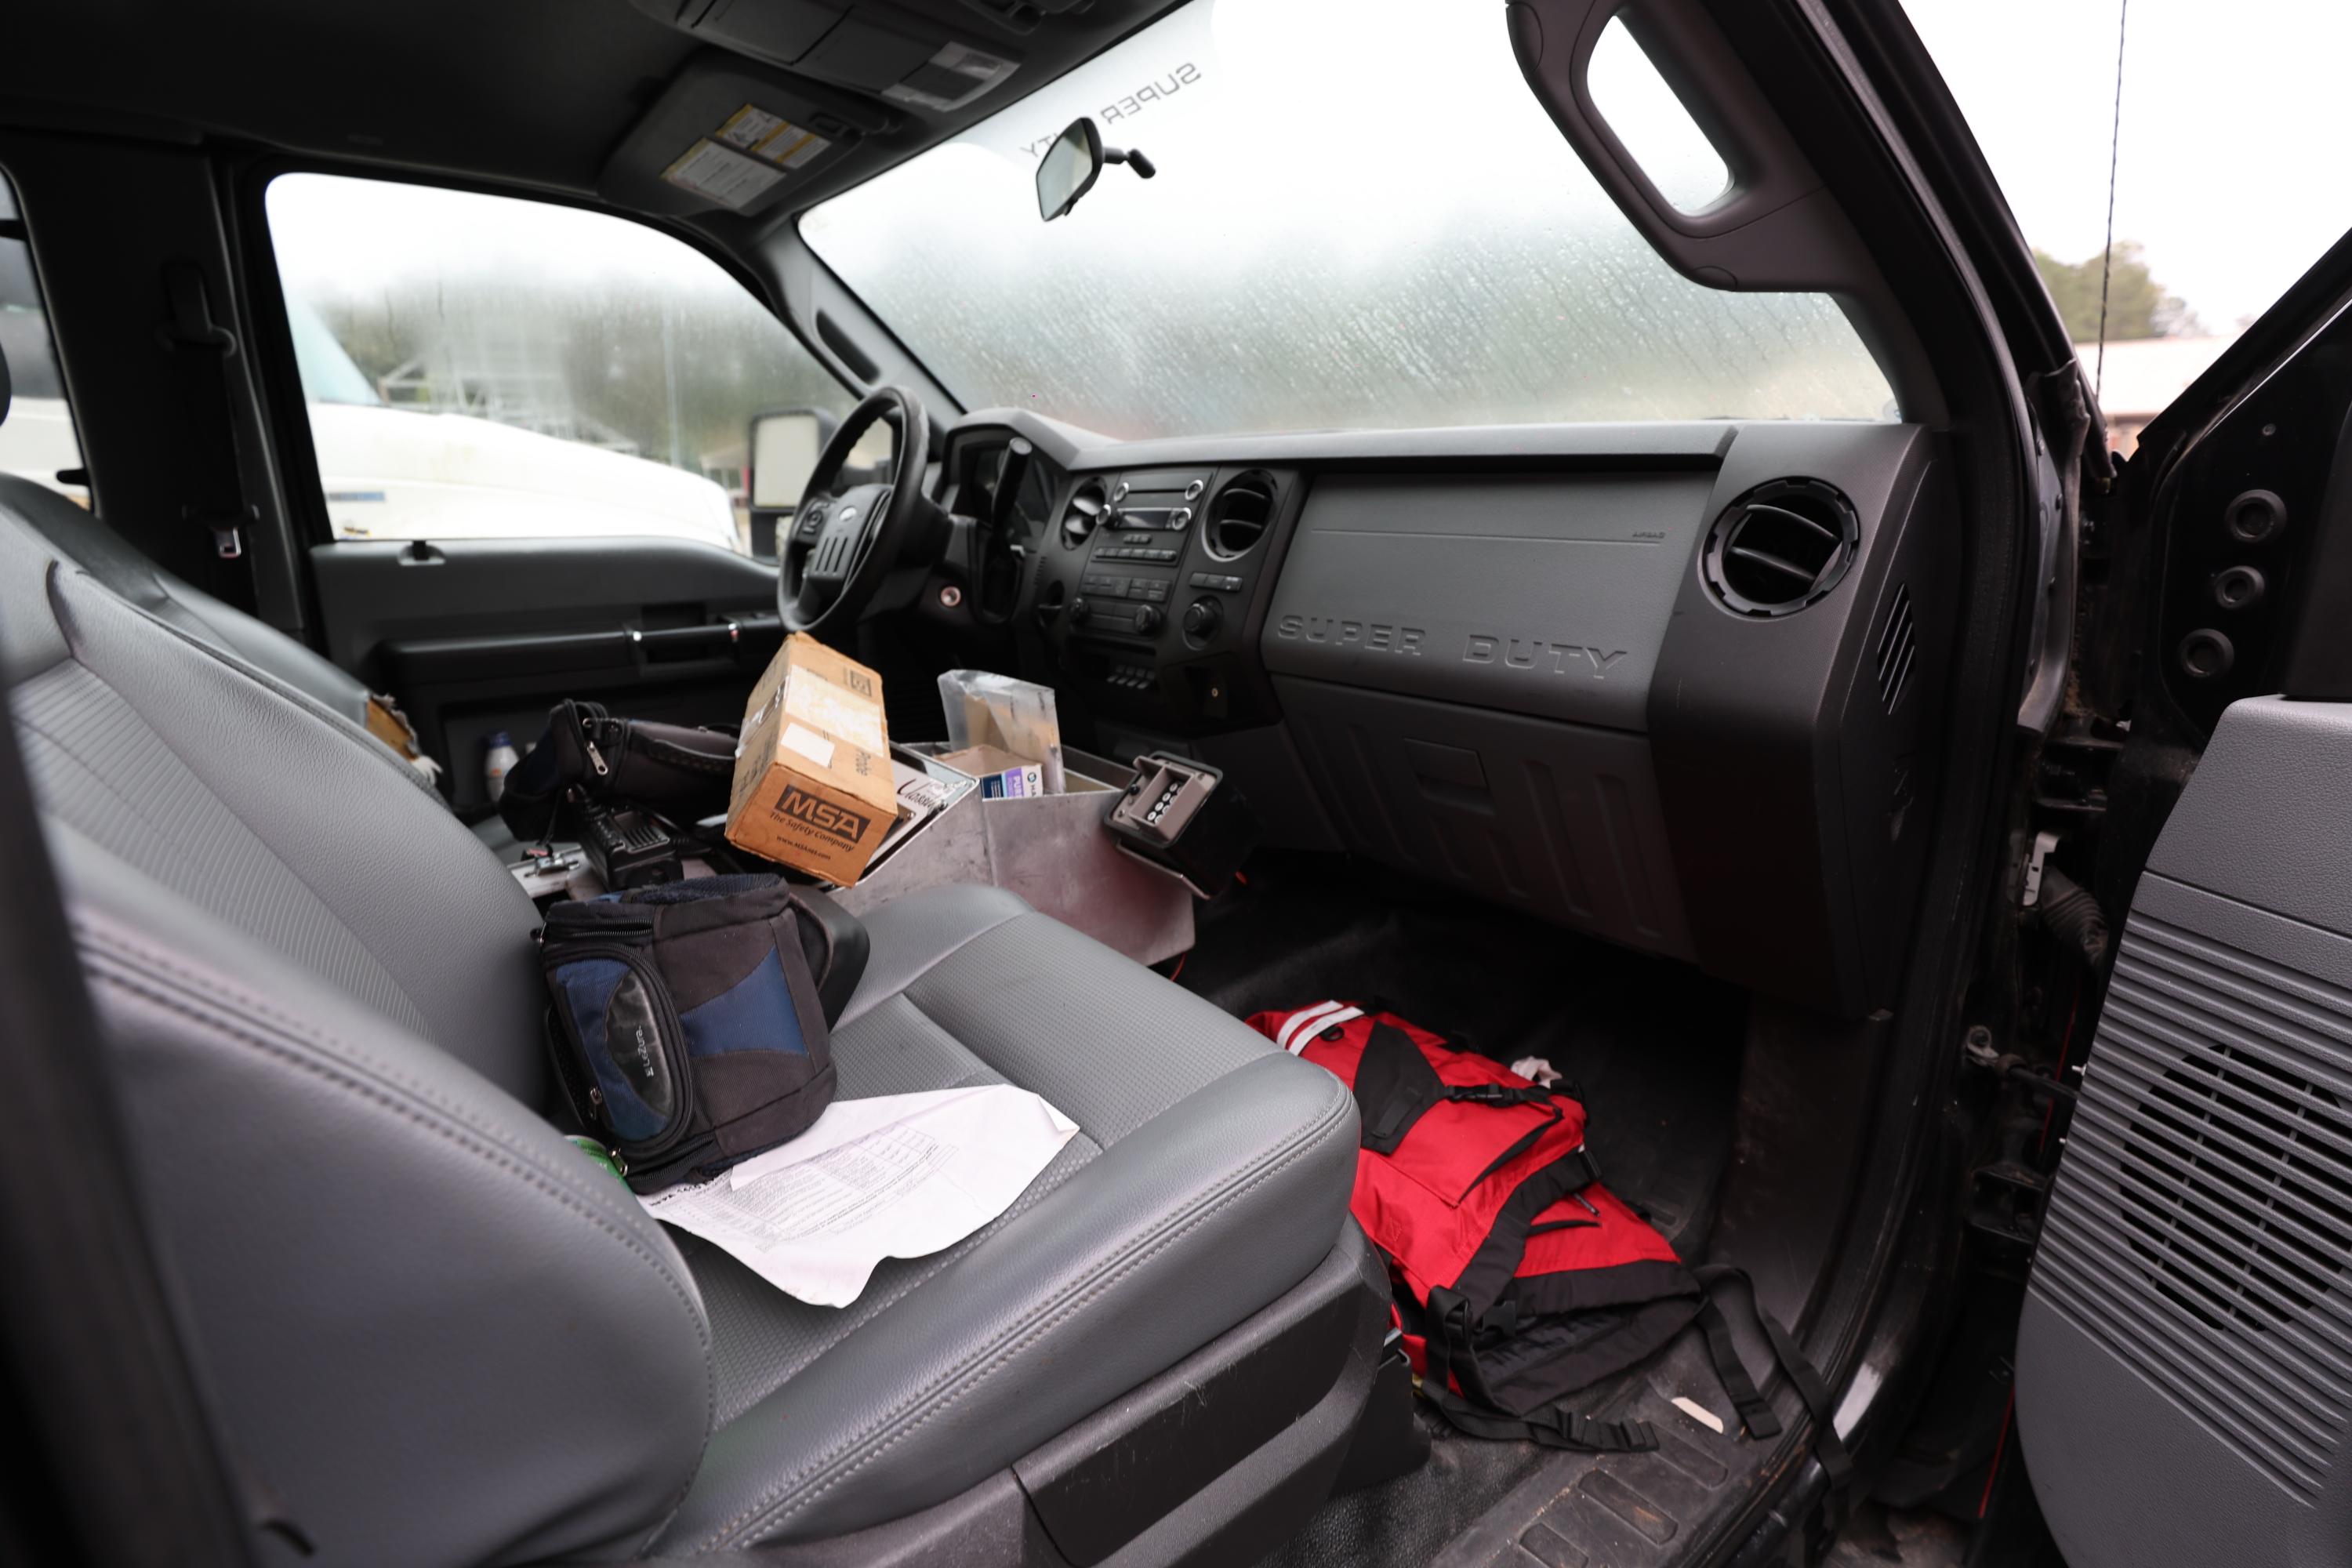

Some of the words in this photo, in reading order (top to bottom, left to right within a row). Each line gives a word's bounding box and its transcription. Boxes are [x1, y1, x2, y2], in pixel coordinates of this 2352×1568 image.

[1277, 615, 1427, 656] SUPER
[1462, 633, 1628, 680] DUTY
[769, 811, 784, 824] The
[786, 818, 815, 836] Safety
[815, 831, 855, 853] Company
[781, 789, 860, 840] MSA
